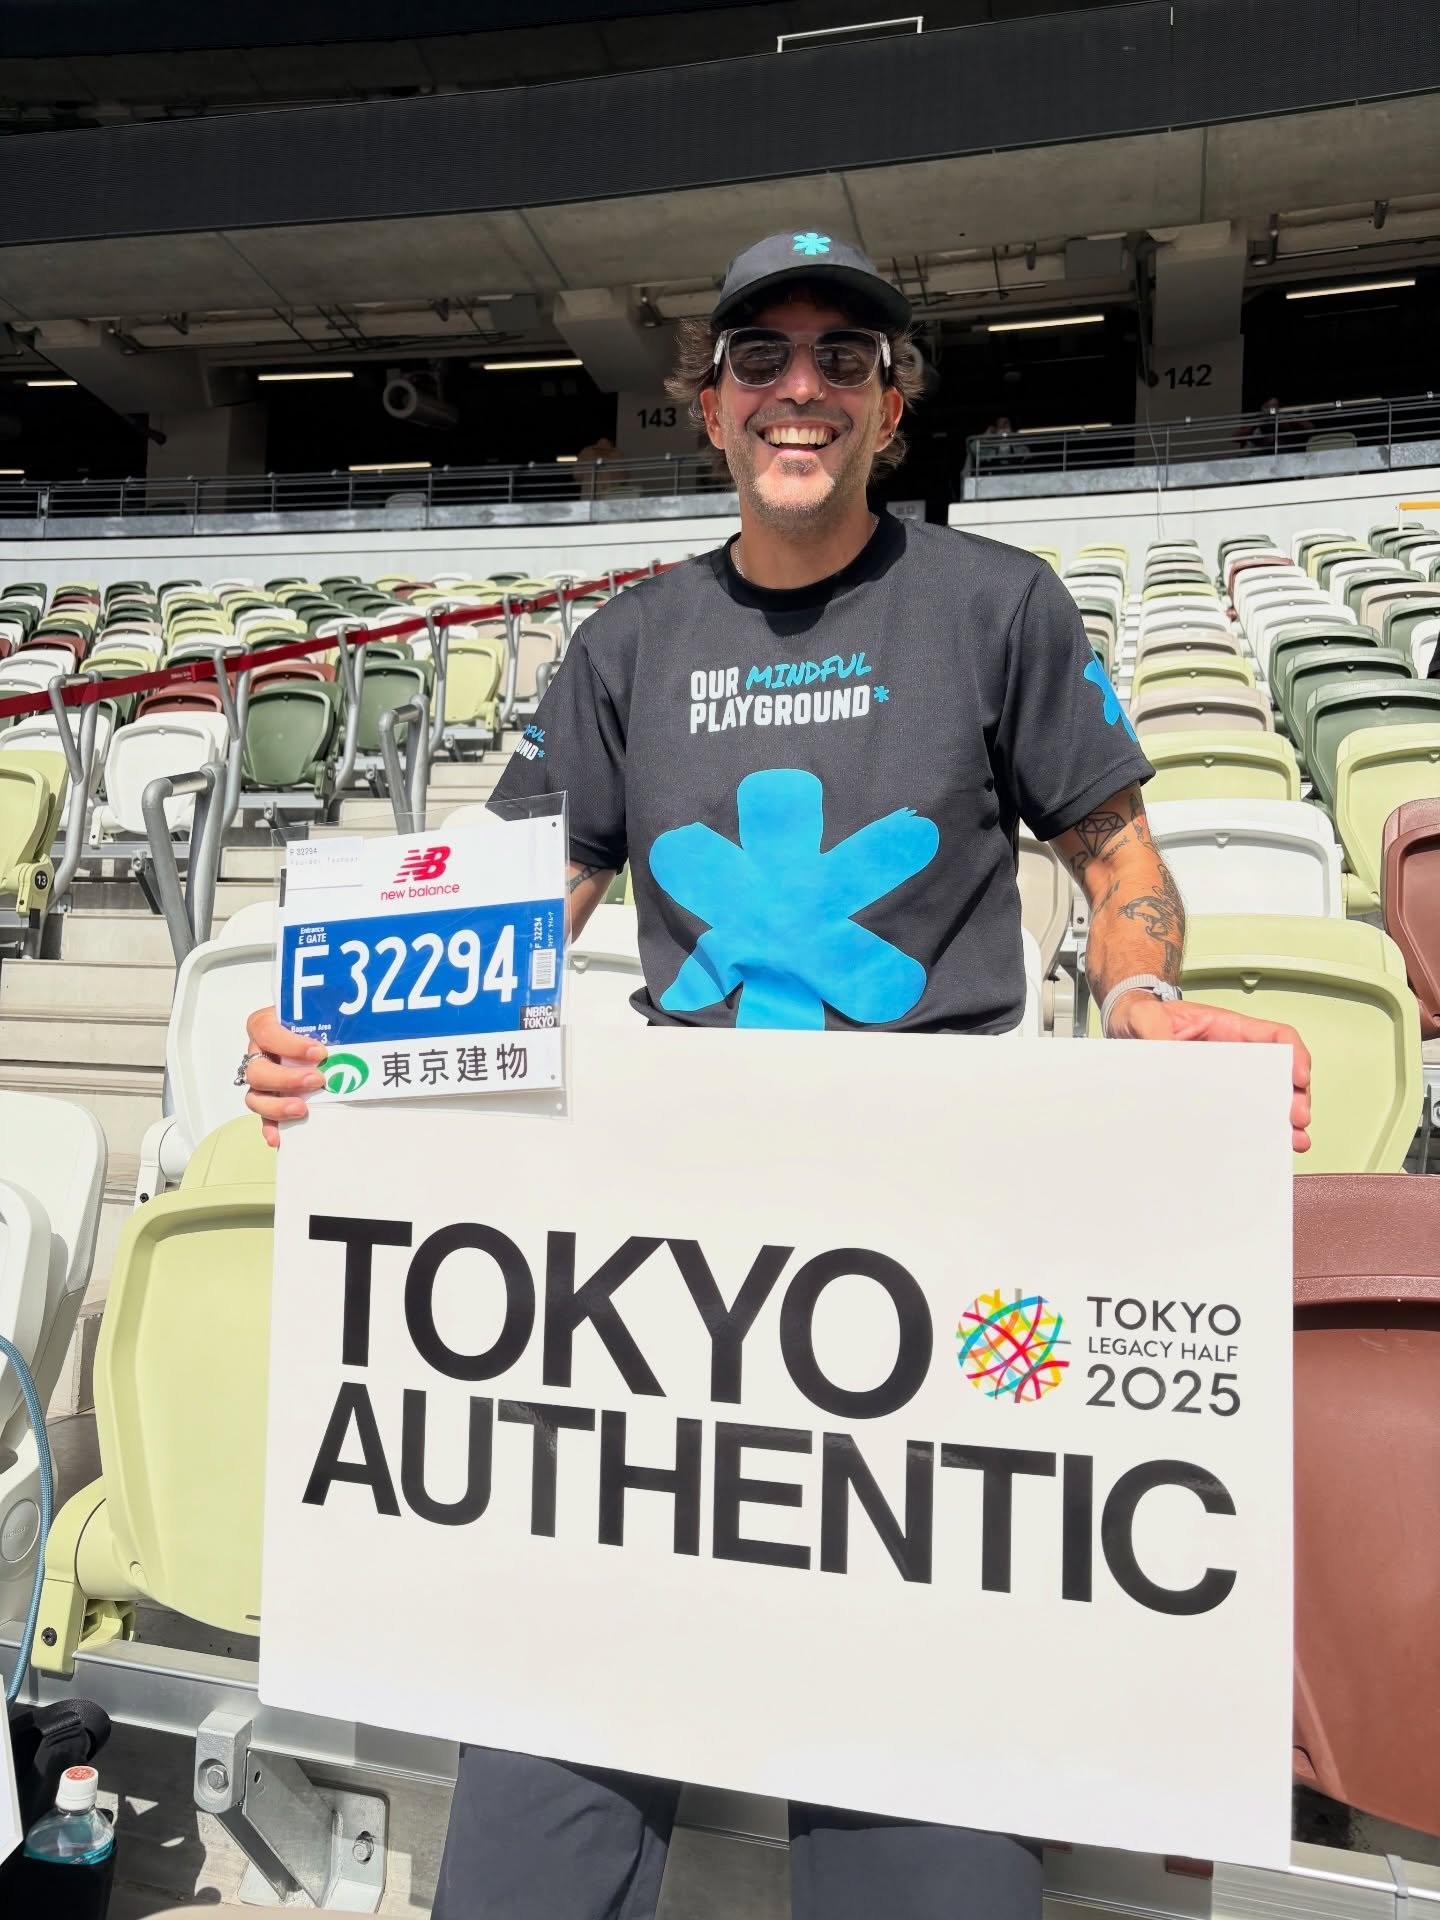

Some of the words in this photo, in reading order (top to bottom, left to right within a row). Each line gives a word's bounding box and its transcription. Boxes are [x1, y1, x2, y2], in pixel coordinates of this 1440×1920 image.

[1164, 363, 1212, 389] 142
[637, 407, 677, 429] 143
[690, 666, 740, 701] OUR
[745, 652, 872, 690] MINDFUL
[37, 875, 47, 886] 13
[381, 889, 406, 901] new
[408, 884, 460, 898] balance
[298, 935, 305, 945] E
[306, 933, 327, 944] GATE
[300, 927, 325, 935] Entrance
[294, 945, 330, 1020] F
[338, 924, 518, 1016] 32294
[523, 1016, 555, 1029] TOKYO
[525, 1005, 553, 1018] NBRC
[291, 1025, 317, 1033] Baggage
[317, 1023, 332, 1031] Area
[320, 1032, 328, 1045] 3
[381, 1043, 528, 1087] 東京建物
[309, 1214, 933, 1419] TOKYO
[1087, 1296, 1241, 1336] TOKYO
[1088, 1337, 1173, 1358] LEGACY
[1181, 1342, 1239, 1362] HALF
[1085, 1363, 1241, 1417] 2025
[302, 1381, 1238, 1616] AUTHENTIC
